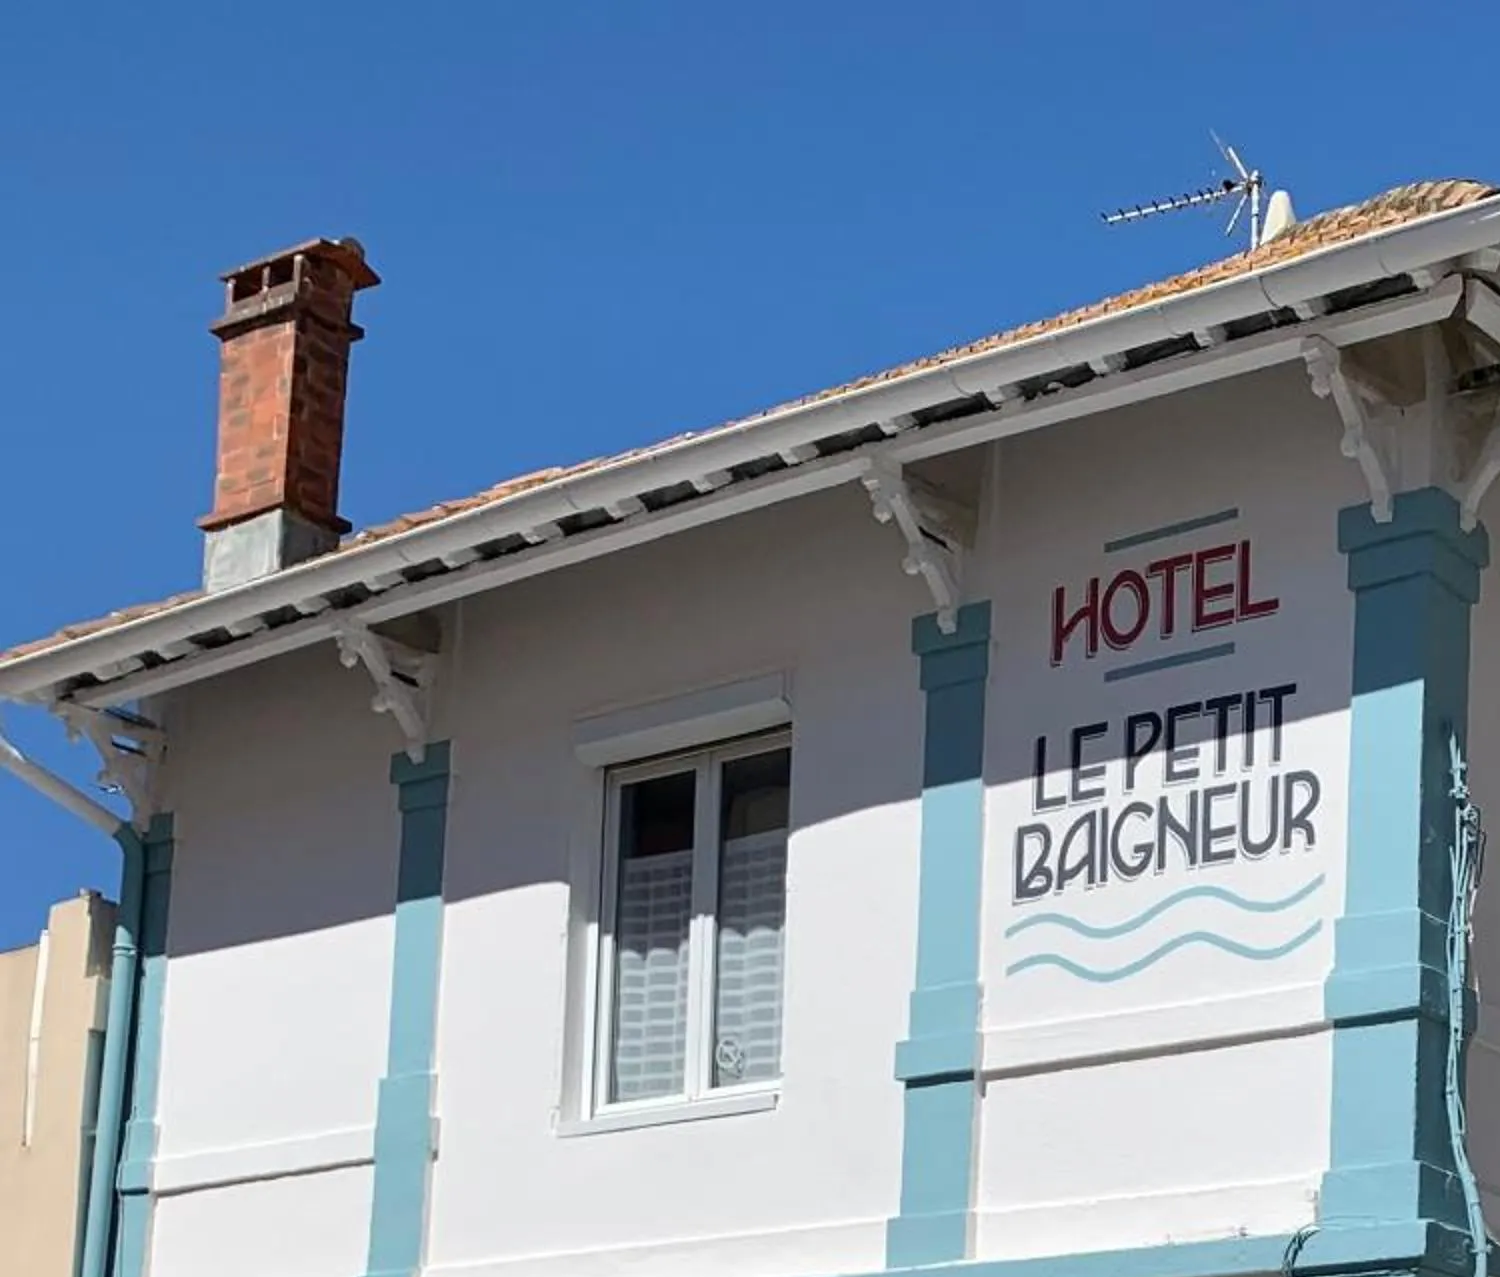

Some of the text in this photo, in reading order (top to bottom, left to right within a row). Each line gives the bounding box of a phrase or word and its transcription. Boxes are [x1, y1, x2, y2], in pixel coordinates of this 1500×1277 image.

[1051, 540, 1279, 667] HOTEL
[1033, 683, 1297, 815] LE PETIT
[1012, 768, 1321, 906] BAIGNEUR
